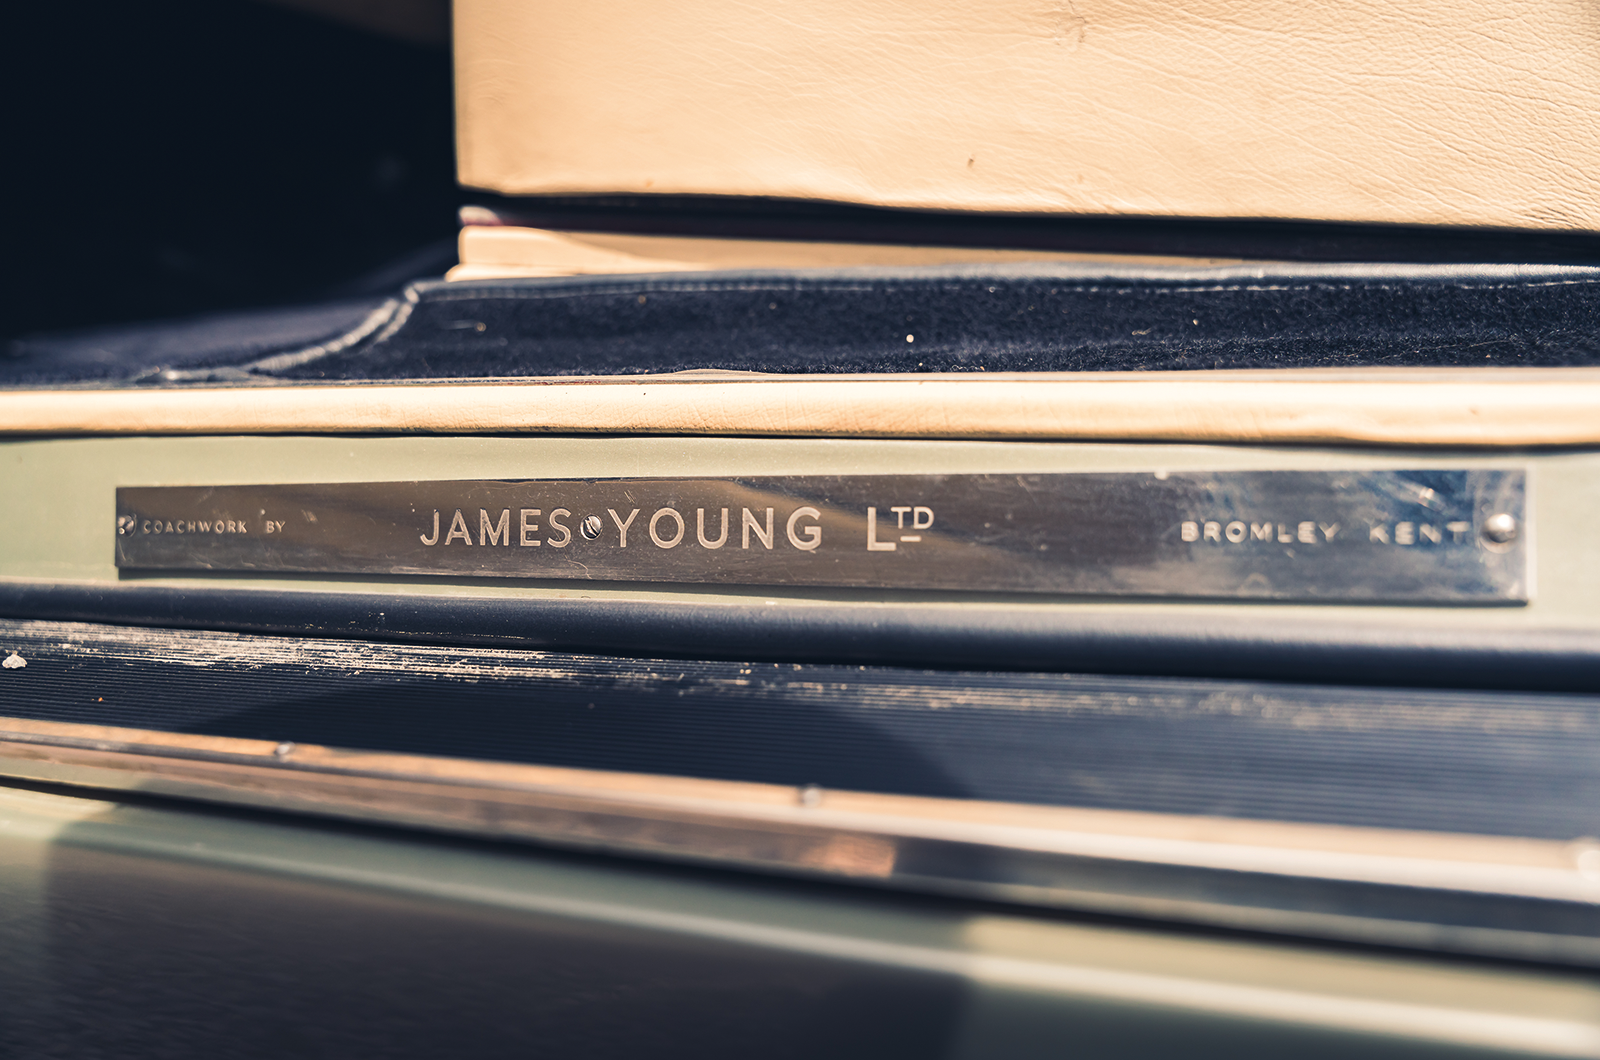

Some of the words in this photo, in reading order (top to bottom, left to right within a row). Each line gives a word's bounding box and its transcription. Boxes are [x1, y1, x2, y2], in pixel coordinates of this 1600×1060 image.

[142, 519, 248, 535] COACHWORK
[265, 520, 287, 535] BY
[419, 507, 573, 548] JAMES
[607, 506, 822, 551] YOUNG
[867, 506, 935, 551] LTD
[1181, 520, 1341, 544] BROMLEY
[1368, 520, 1471, 545] KENT
